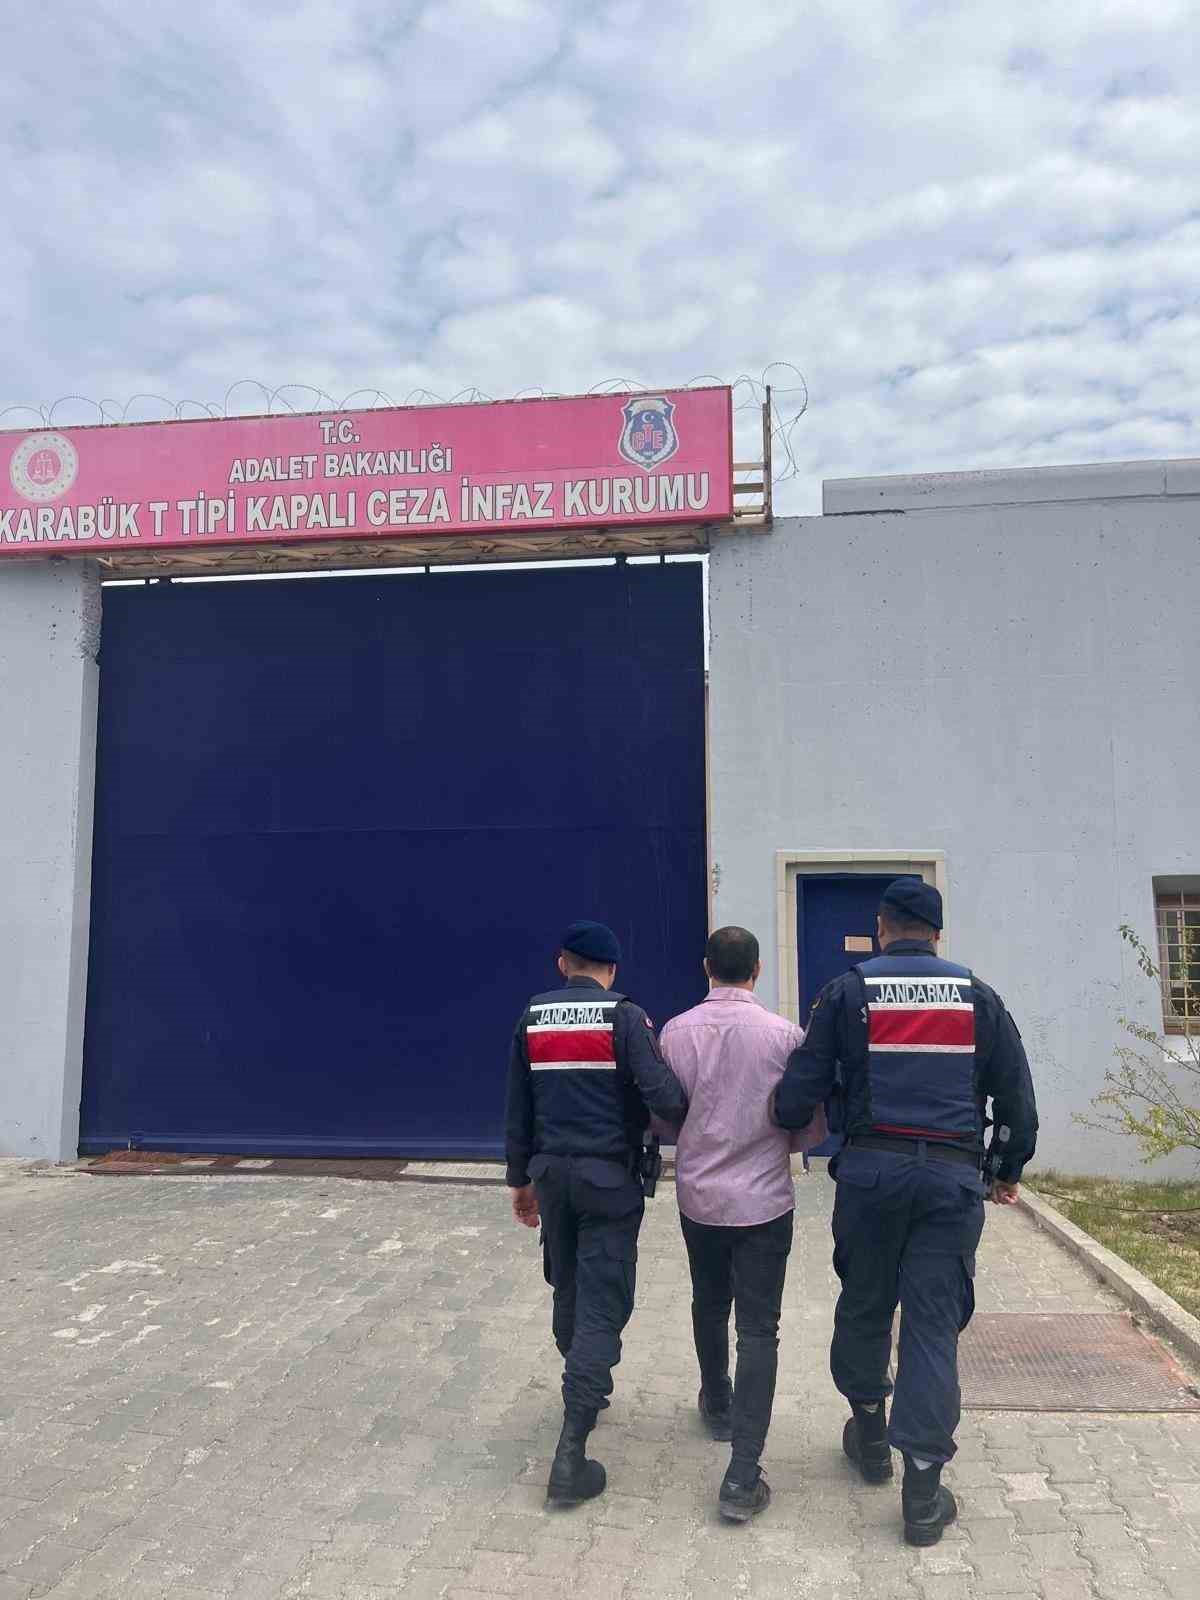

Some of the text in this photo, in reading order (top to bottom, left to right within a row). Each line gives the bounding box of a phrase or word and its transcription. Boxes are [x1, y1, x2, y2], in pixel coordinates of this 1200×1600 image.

[319, 419, 361, 445] T.C.
[229, 442, 453, 484] ADALET BAKANLIĞI
[0, 472, 710, 544] KARABÜK T TİPİ KAPALI CEZA İNFAZ KURUMU
[876, 983, 962, 1003] JANDARMA
[536, 1007, 605, 1025] JANDARMA
